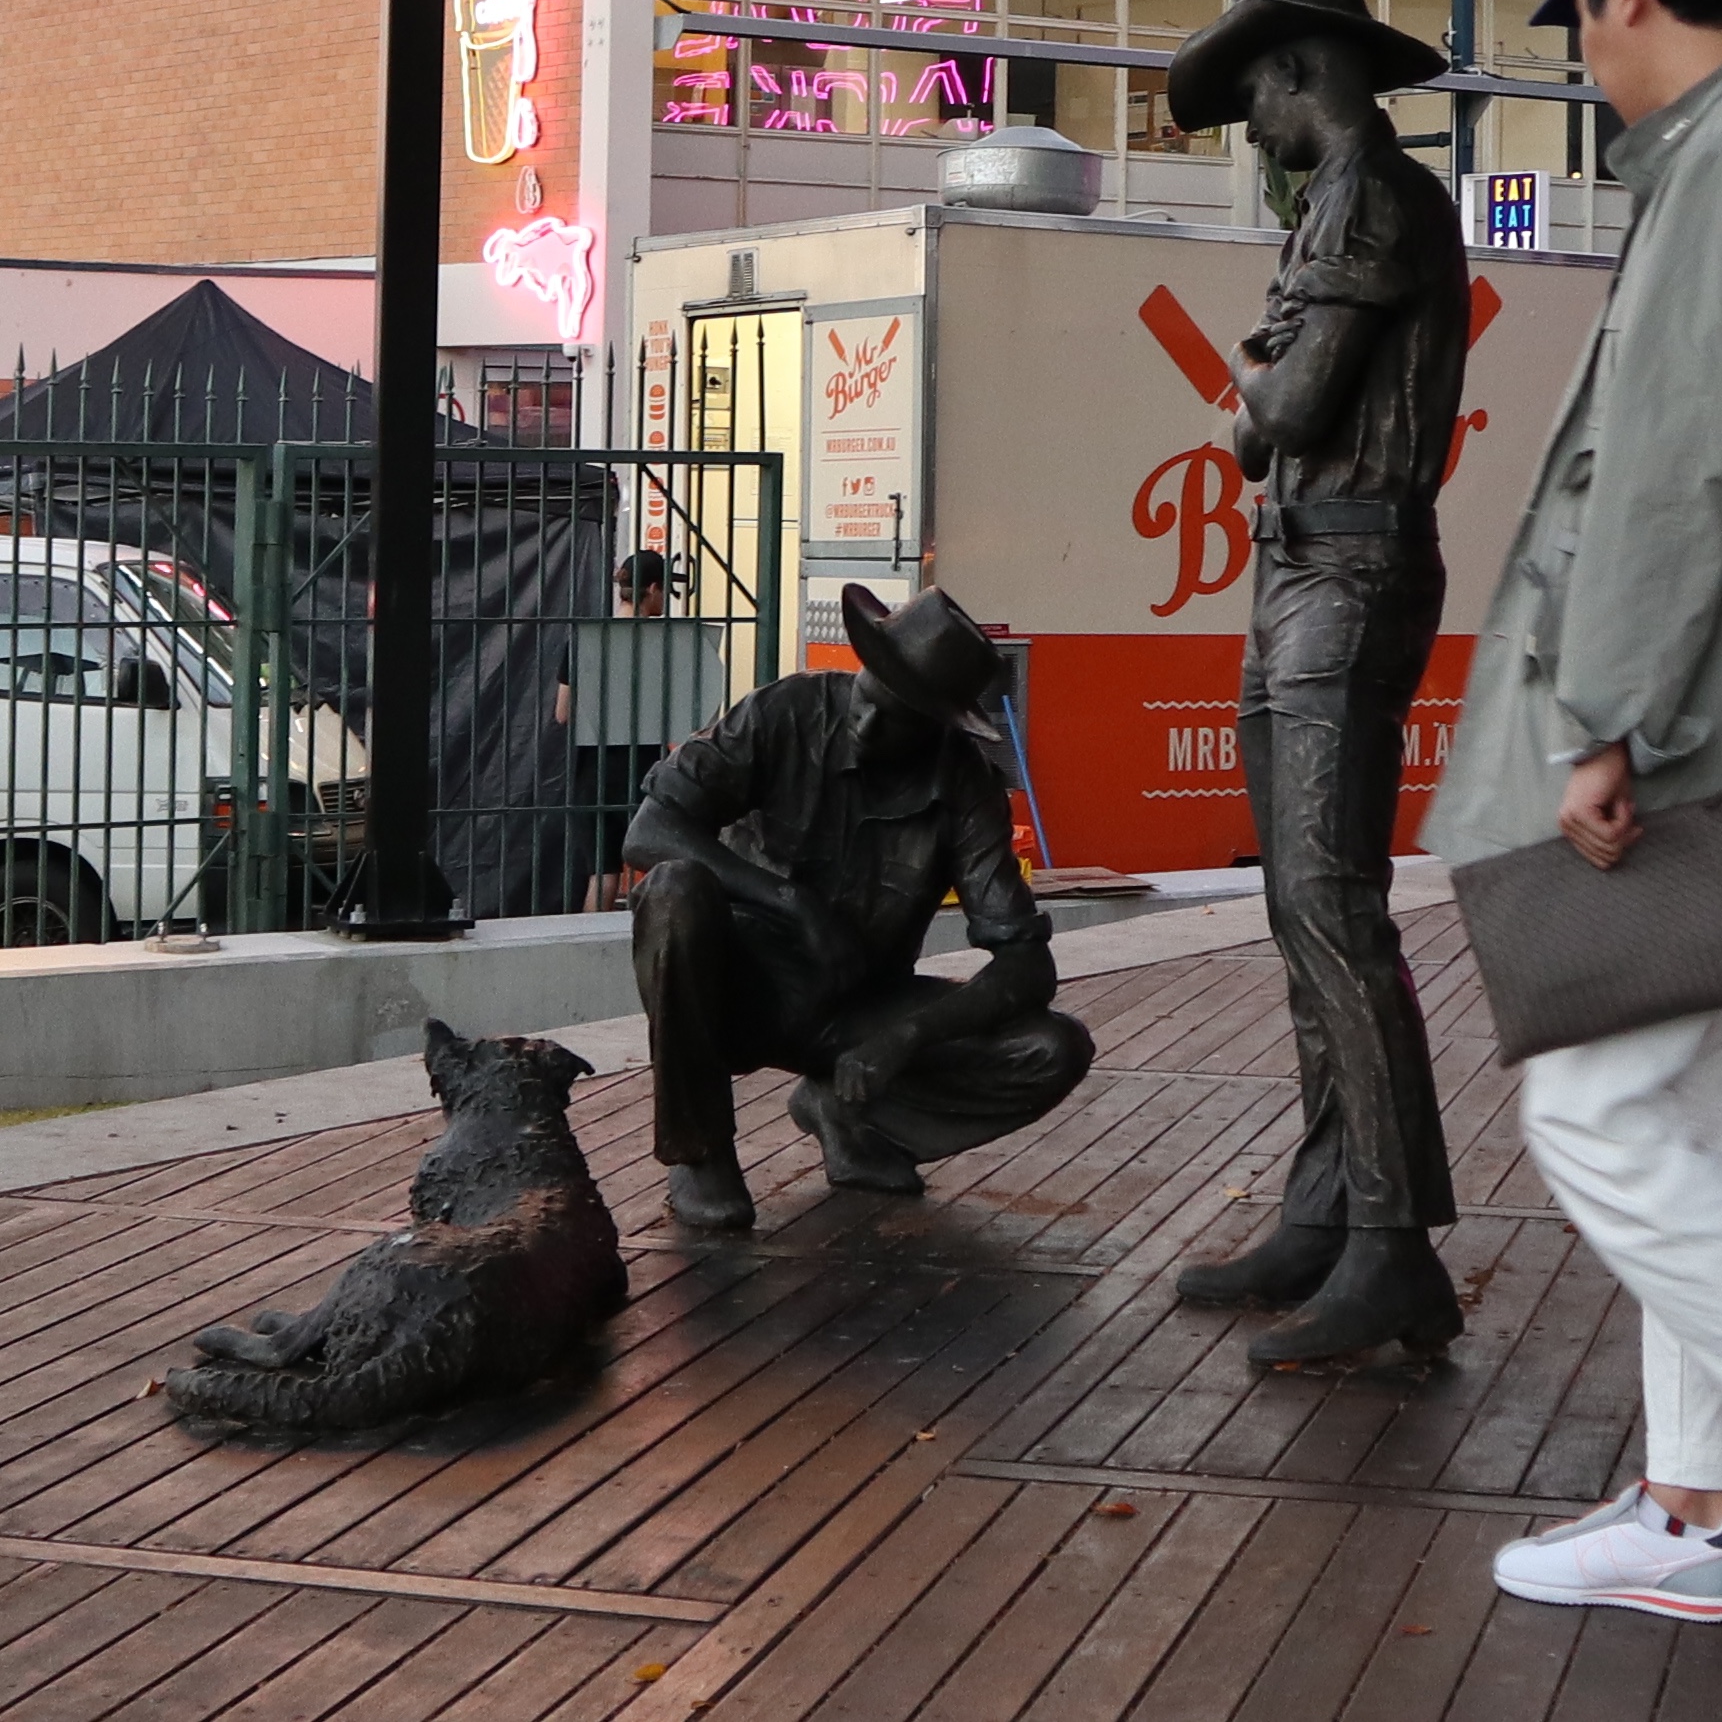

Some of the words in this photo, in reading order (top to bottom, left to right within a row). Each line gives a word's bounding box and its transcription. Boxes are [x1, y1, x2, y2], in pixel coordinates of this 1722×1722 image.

[1494, 177, 1533, 203] EAT
[1495, 204, 1531, 229] EAT
[848, 336, 878, 377] Mr
[825, 355, 898, 420] Burger
